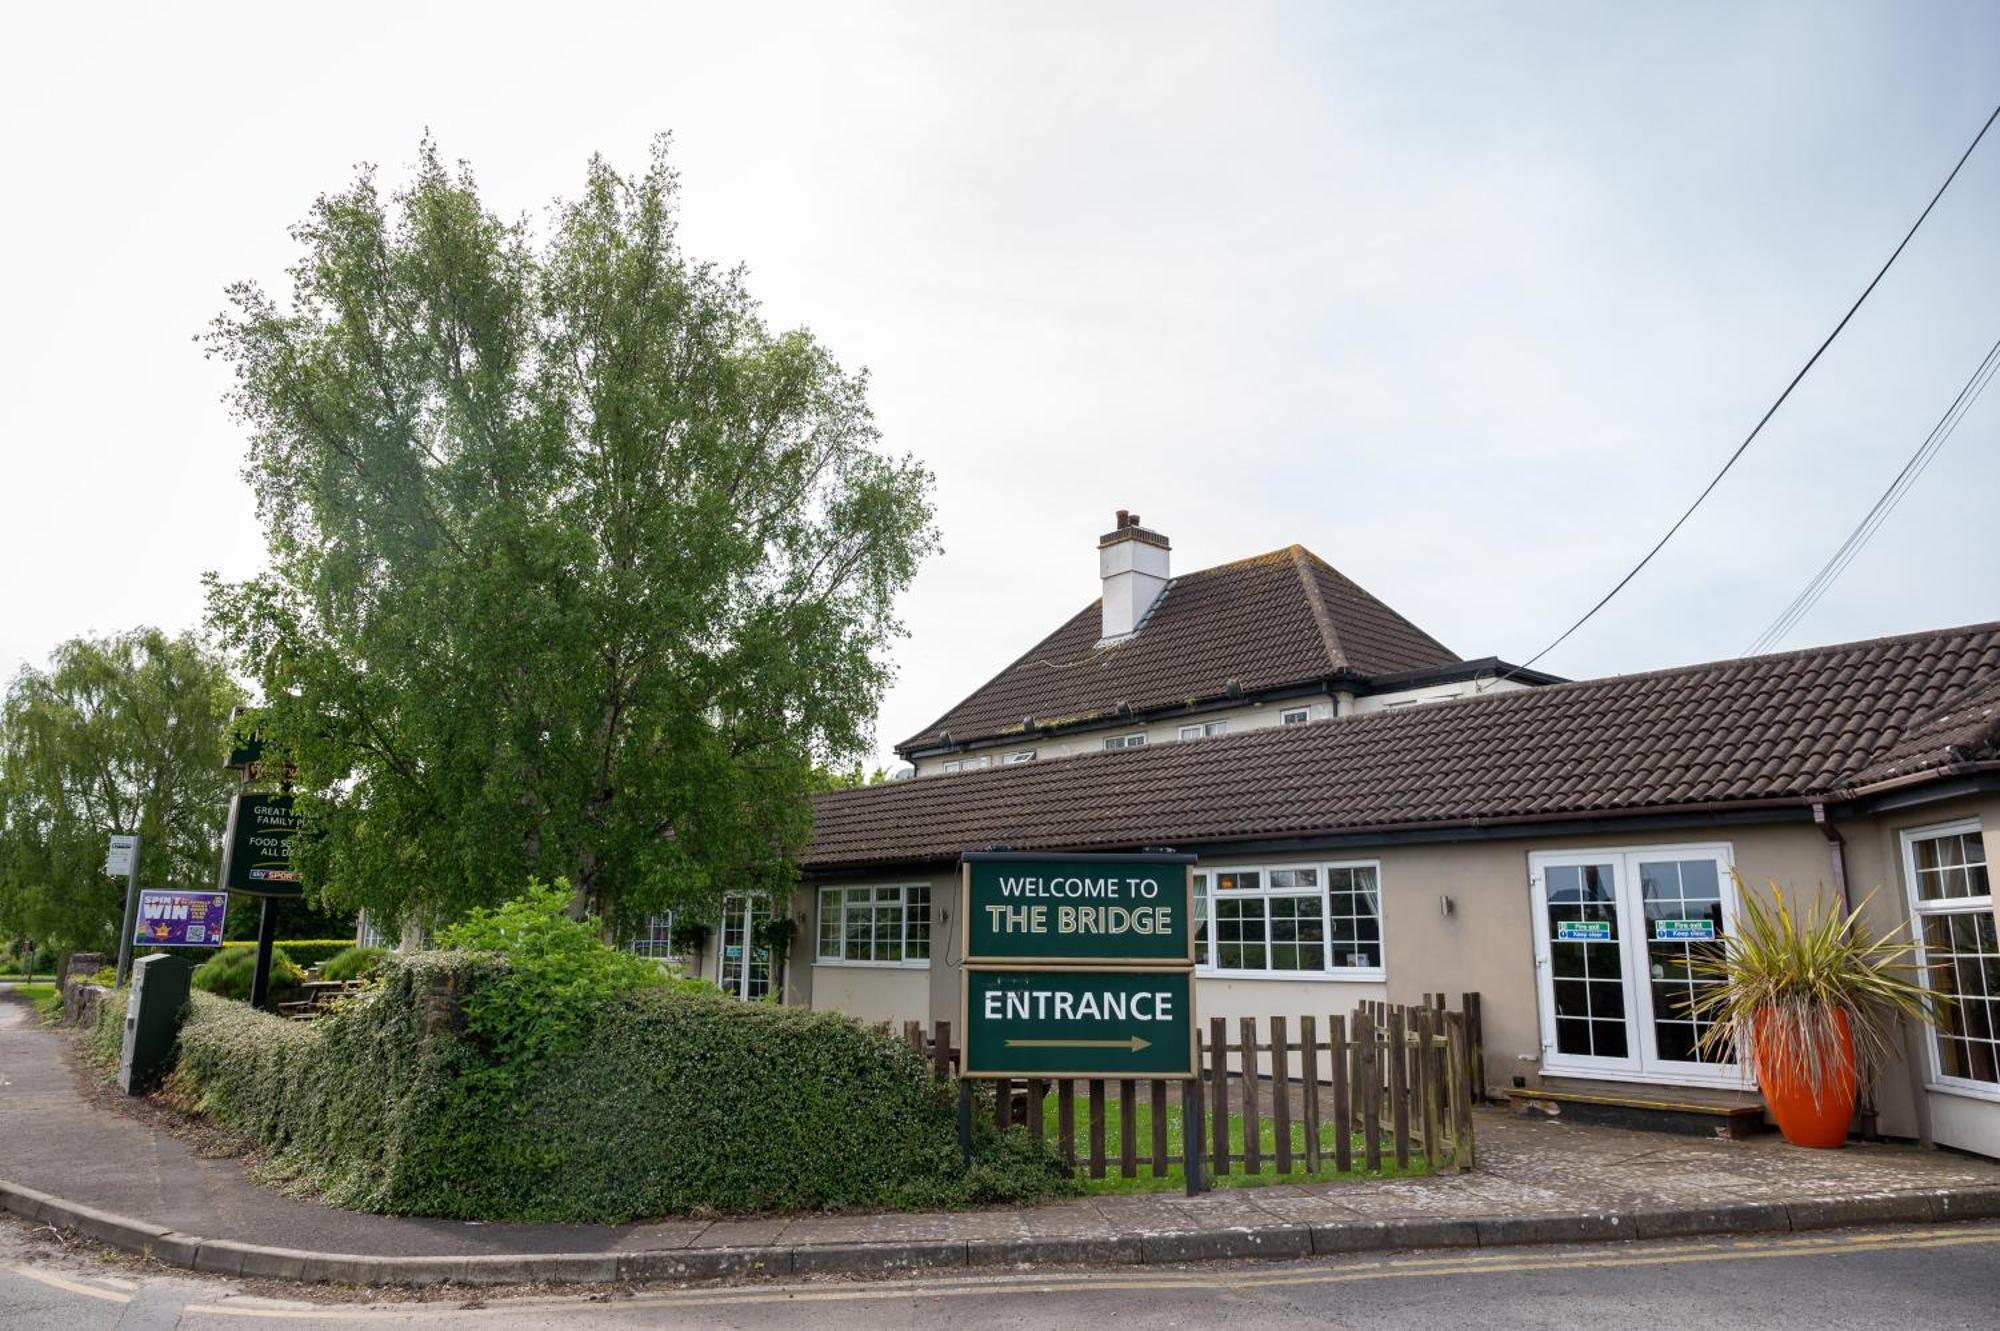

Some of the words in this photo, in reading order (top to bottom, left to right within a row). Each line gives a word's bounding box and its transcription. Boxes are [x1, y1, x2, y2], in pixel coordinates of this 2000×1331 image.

[253, 806, 286, 816] GREAT
[256, 816, 295, 826] FAMILY
[249, 837, 278, 847] FOOD
[260, 848, 279, 857] ALL
[999, 877, 1119, 898] WELCOME
[1126, 878, 1159, 899] TO
[144, 896, 172, 904] SPIN
[143, 904, 189, 920] WIN
[985, 905, 1048, 933] THE
[1058, 906, 1172, 935] BRIDGE
[984, 991, 1173, 1021] ENTRANCE
